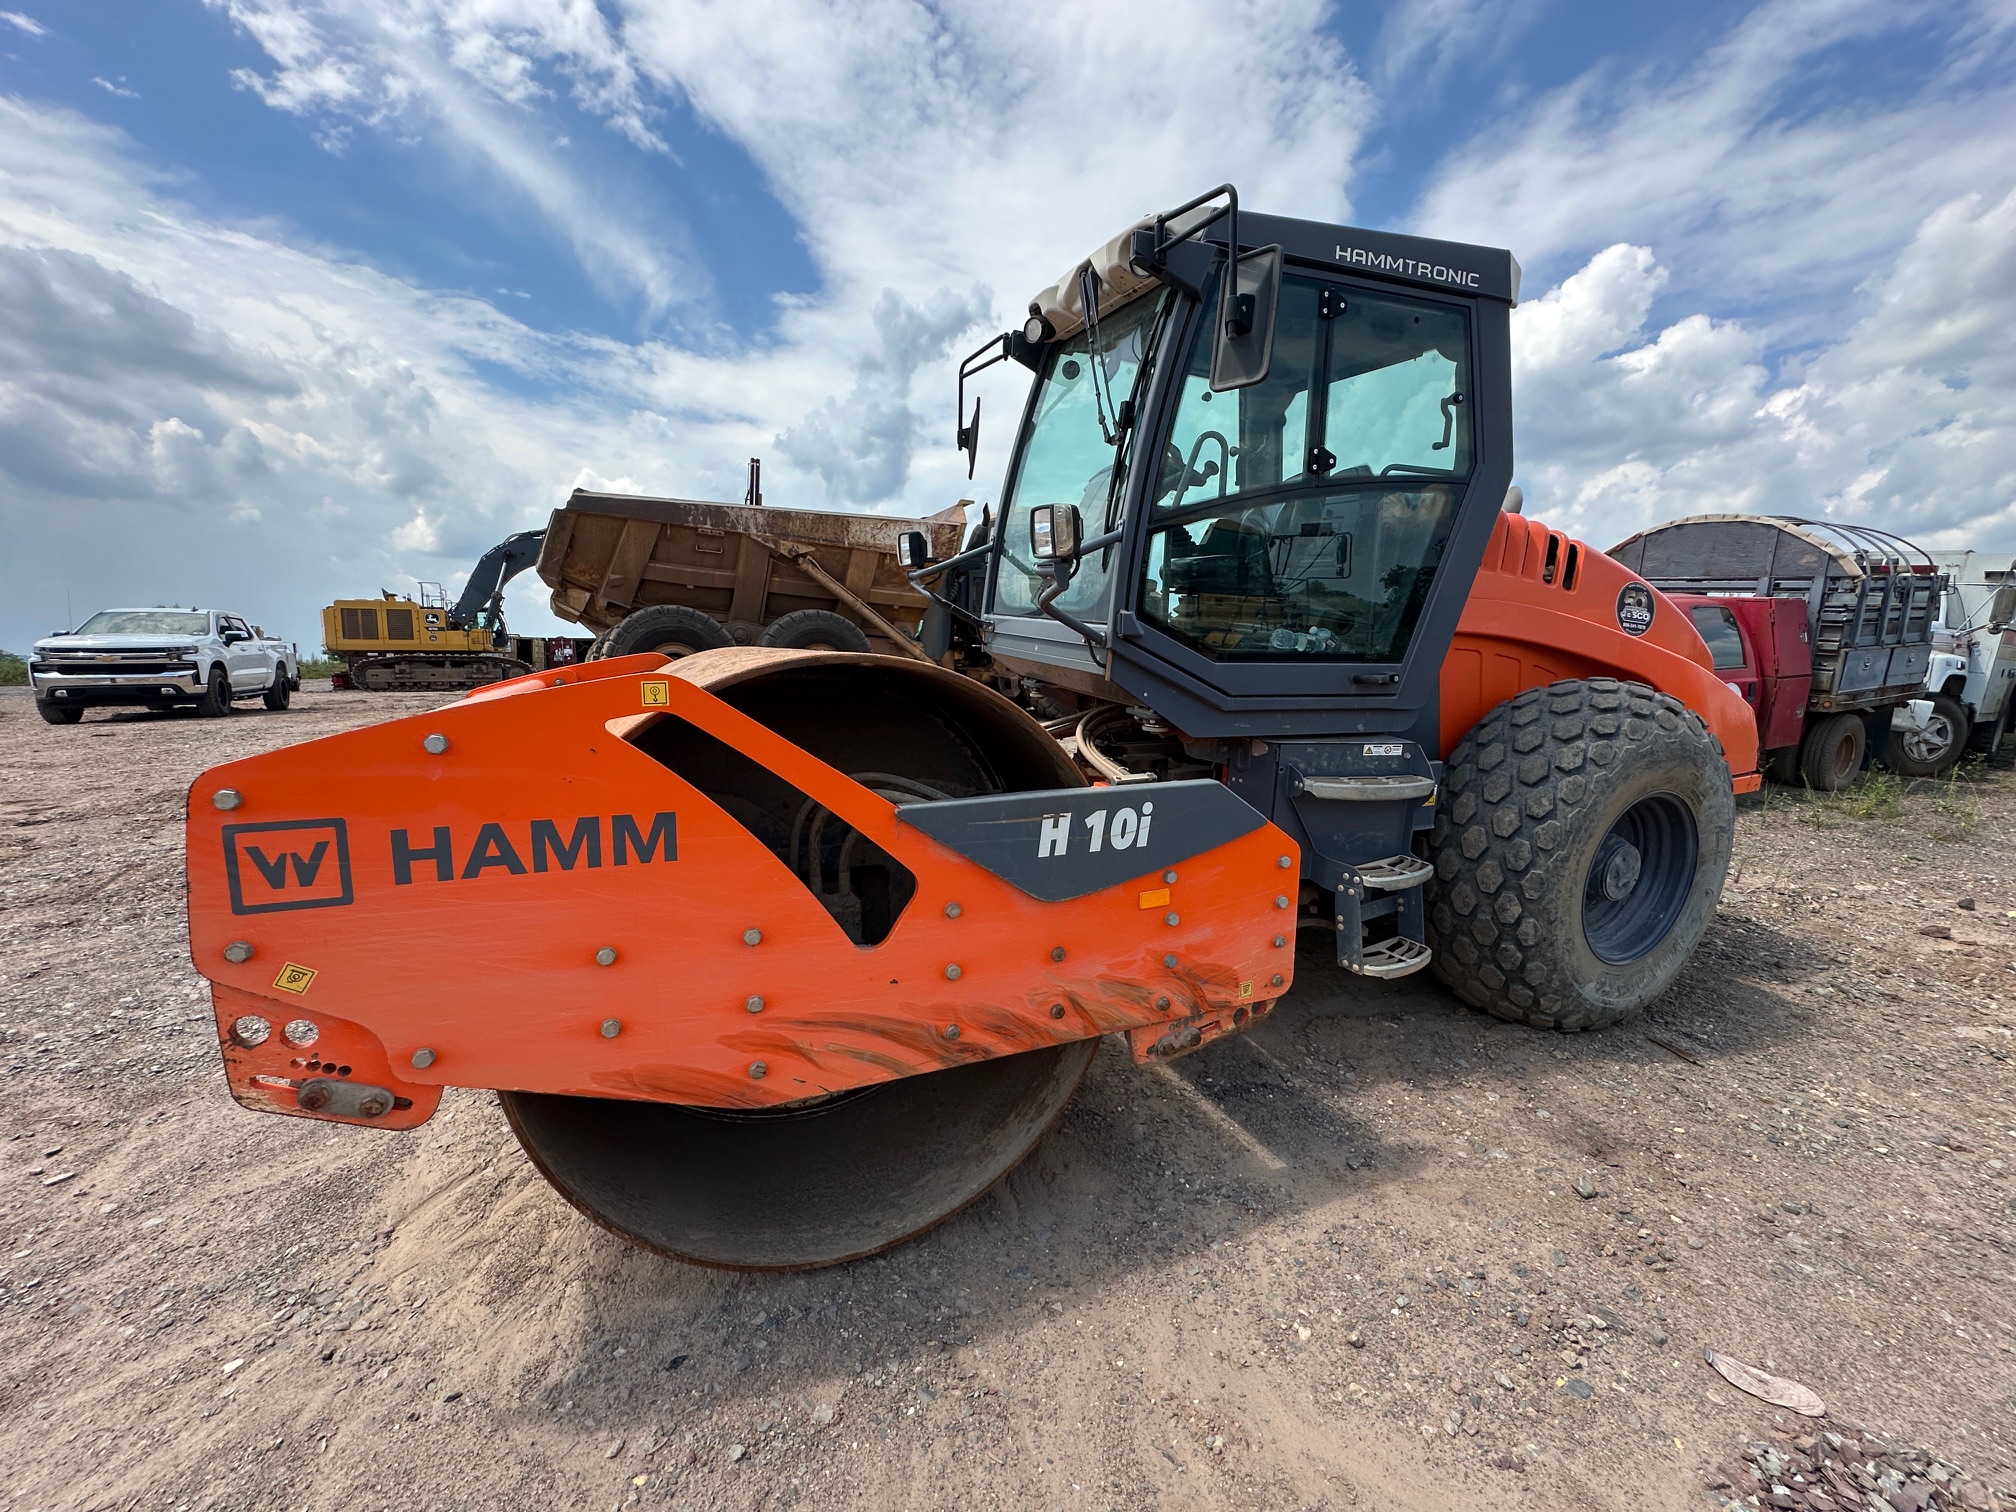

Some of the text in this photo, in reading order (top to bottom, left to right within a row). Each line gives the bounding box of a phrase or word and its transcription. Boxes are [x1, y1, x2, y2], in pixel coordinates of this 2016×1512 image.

[1335, 245, 1480, 287] HAMMTRONIC
[1623, 590, 1648, 608] 50
[390, 811, 678, 885] HAMM
[1037, 801, 1154, 858] H 10i
